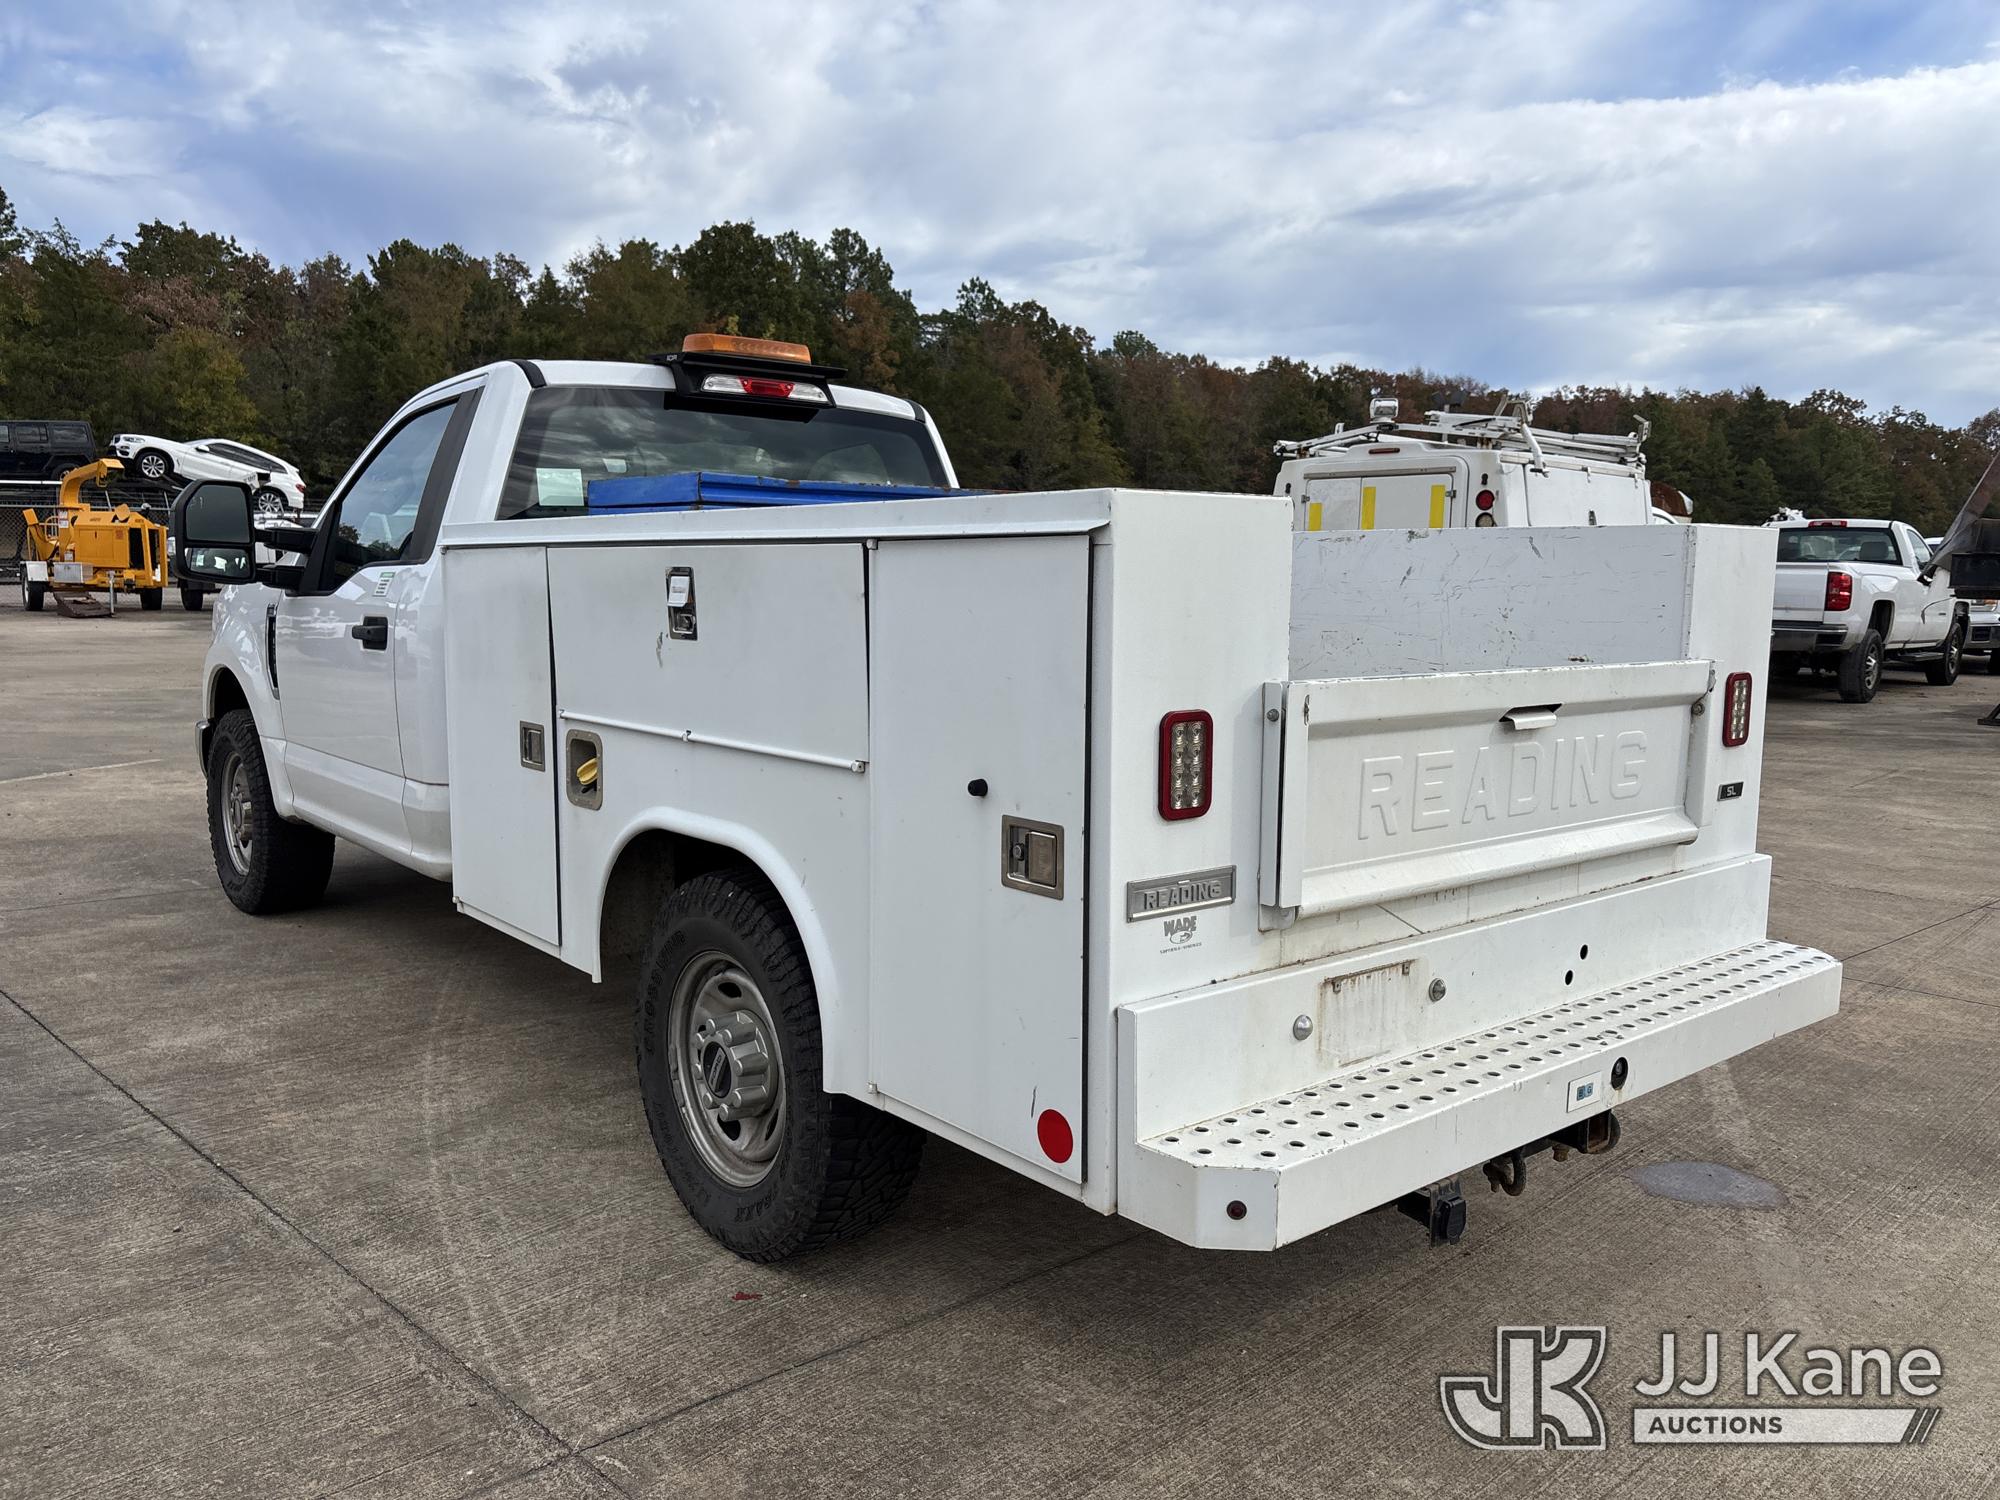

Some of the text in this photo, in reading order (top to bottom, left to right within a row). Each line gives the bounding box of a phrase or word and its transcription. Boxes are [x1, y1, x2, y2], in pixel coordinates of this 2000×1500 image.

[1358, 730, 1648, 840] READING
[1726, 785, 1737, 797] SL
[1143, 879, 1222, 911] READING
[1163, 915, 1198, 937] WADE
[710, 1053, 723, 1088] FORD
